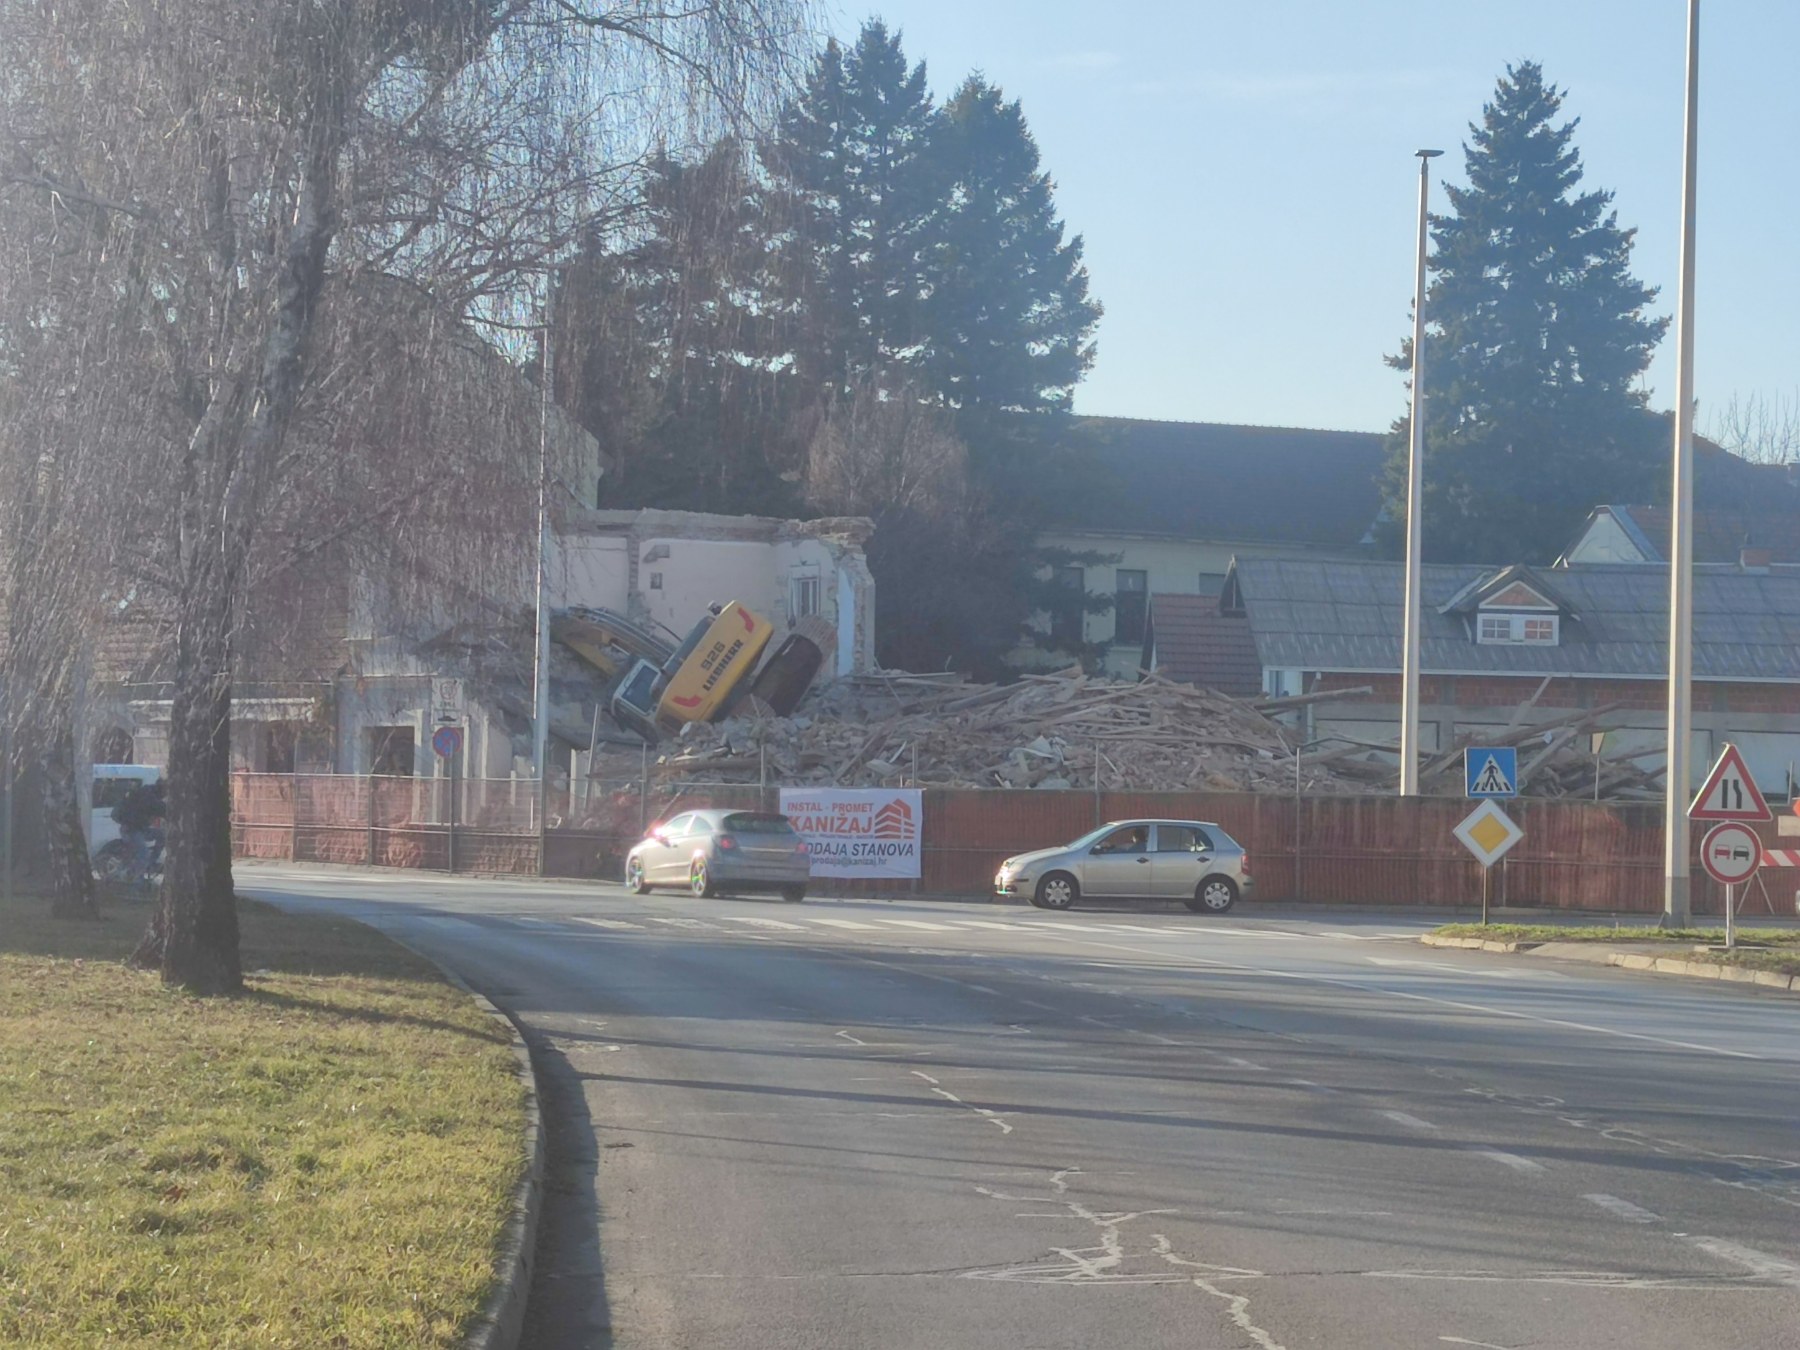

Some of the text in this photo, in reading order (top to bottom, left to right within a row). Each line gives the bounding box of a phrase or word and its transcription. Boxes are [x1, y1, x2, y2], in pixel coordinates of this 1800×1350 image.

[701, 641, 725, 671] 926
[702, 639, 743, 691] LIEBHERR
[787, 802, 823, 812] INSTAL
[832, 802, 874, 812] PROMET
[787, 814, 873, 833] KANIŽAJ
[807, 842, 914, 856] ODAJA STANOVA
